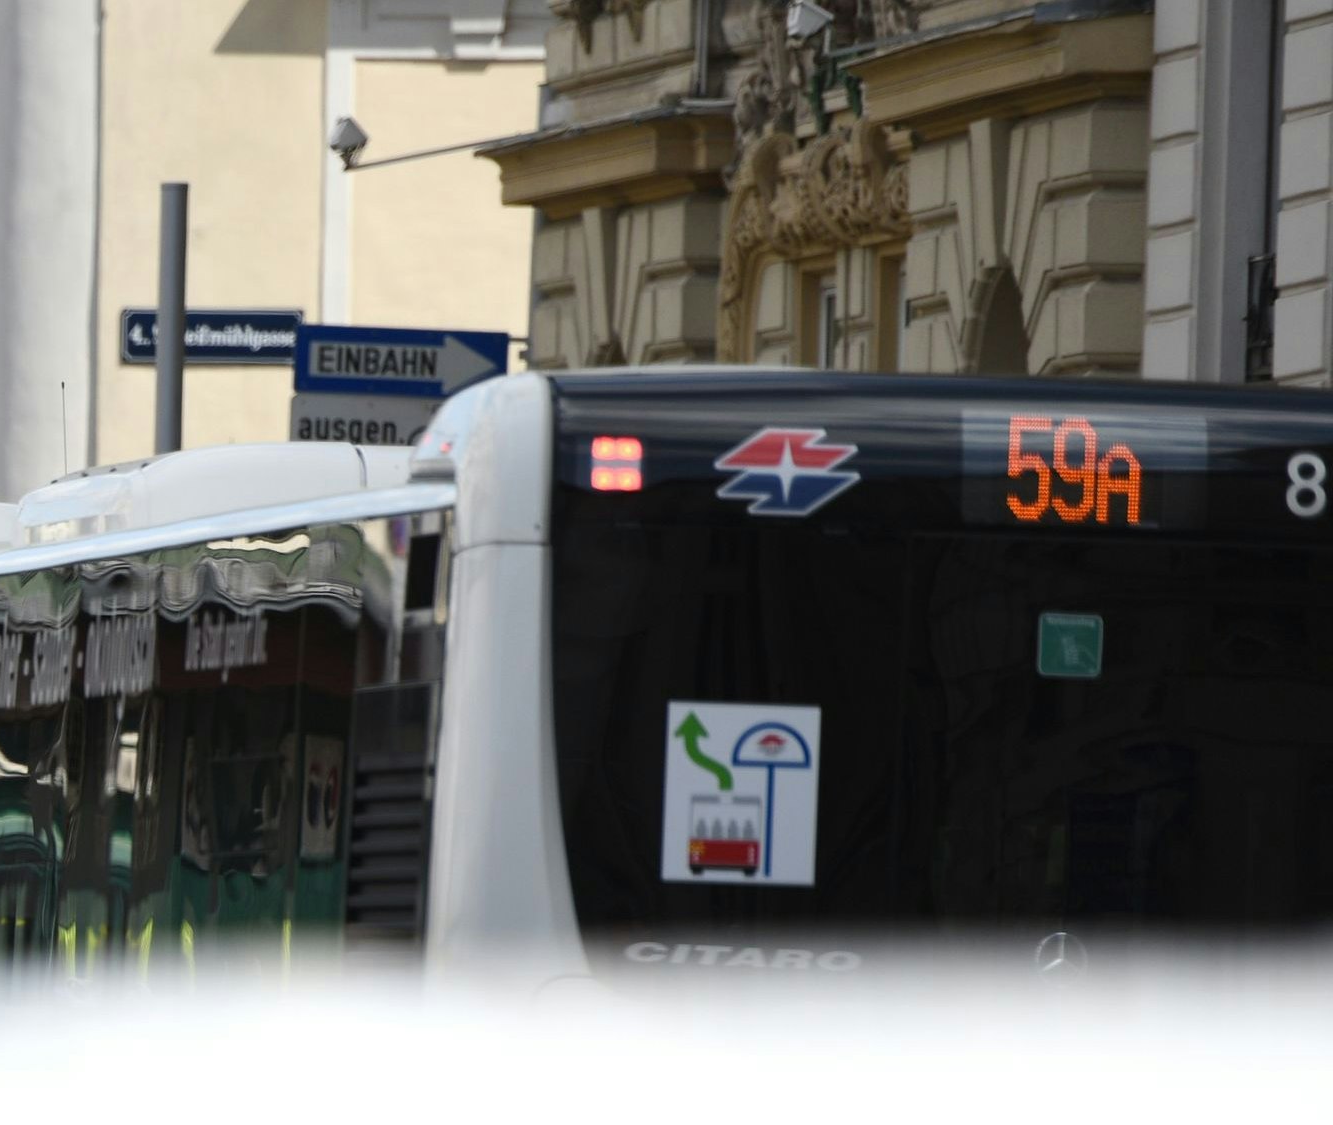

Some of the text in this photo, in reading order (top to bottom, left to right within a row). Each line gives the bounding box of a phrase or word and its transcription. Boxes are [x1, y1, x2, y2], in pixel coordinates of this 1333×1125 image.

[129, 322, 151, 345] 4.
[318, 345, 438, 376] EINBAHN
[298, 416, 405, 444] ausgen.
[1006, 414, 1142, 524] 59A
[1285, 453, 1326, 516] 8
[624, 941, 862, 972] CITARO
